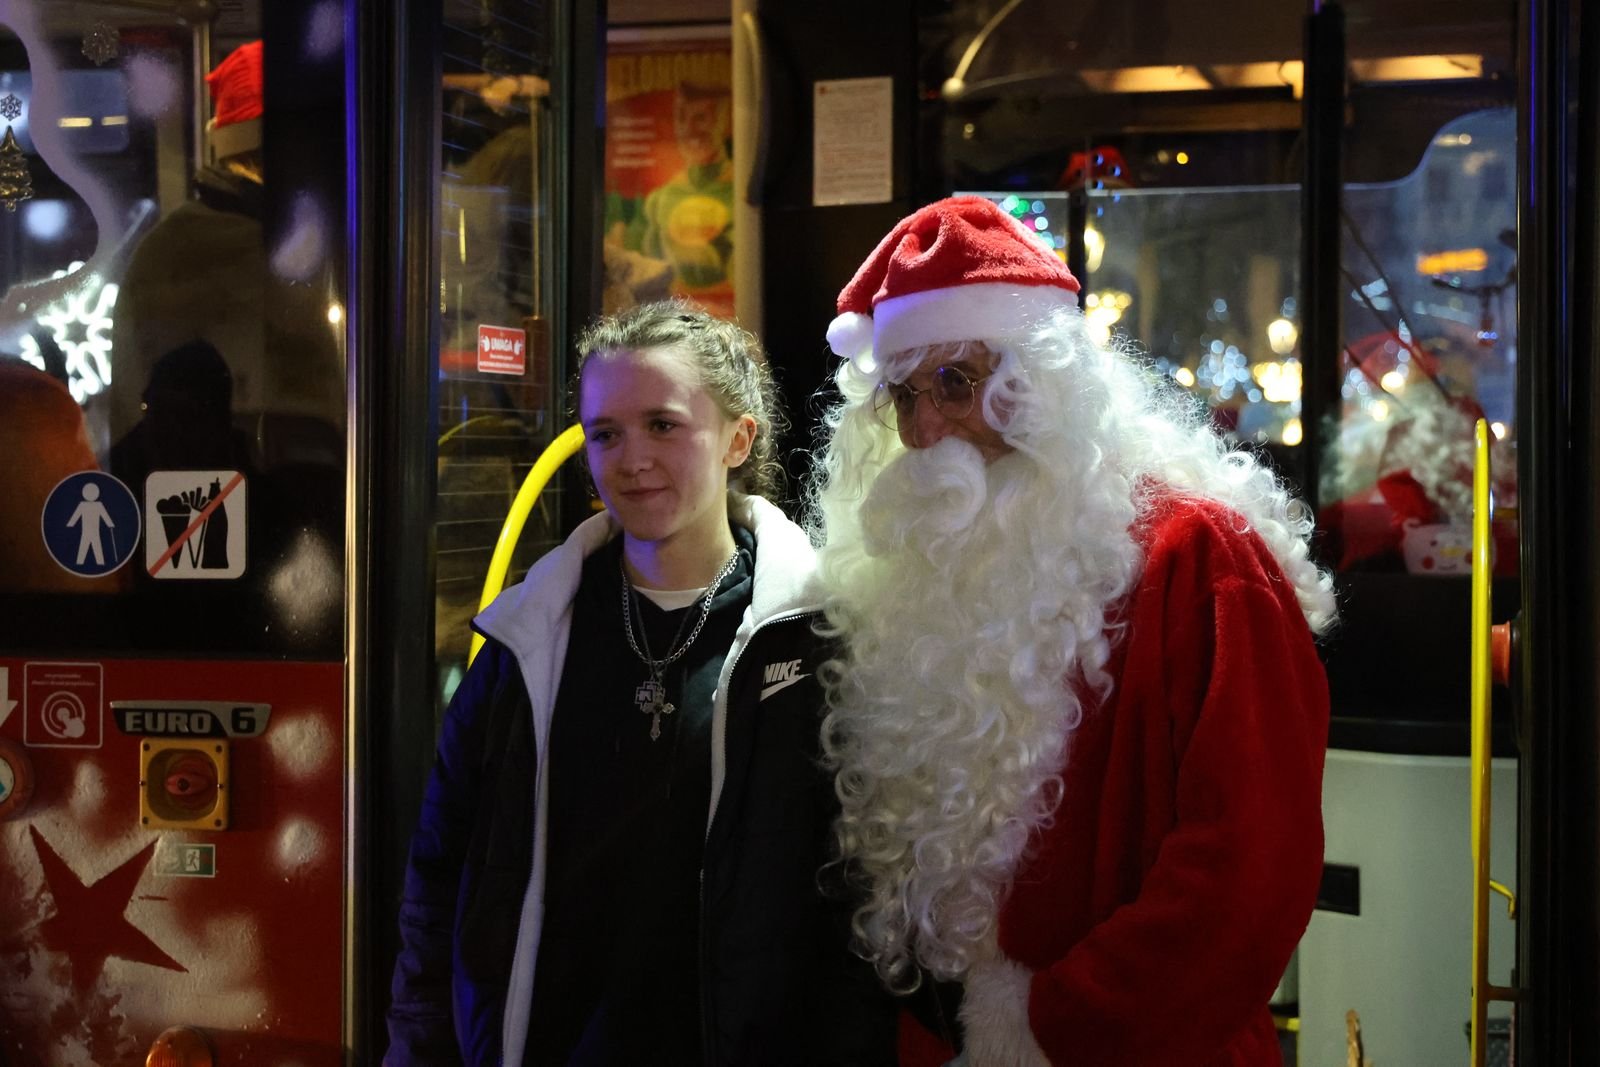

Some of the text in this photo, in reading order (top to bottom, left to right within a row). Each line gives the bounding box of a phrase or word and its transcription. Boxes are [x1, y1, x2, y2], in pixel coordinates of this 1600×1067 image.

[763, 659, 802, 685] NIKE
[125, 707, 257, 734] EURO 6
